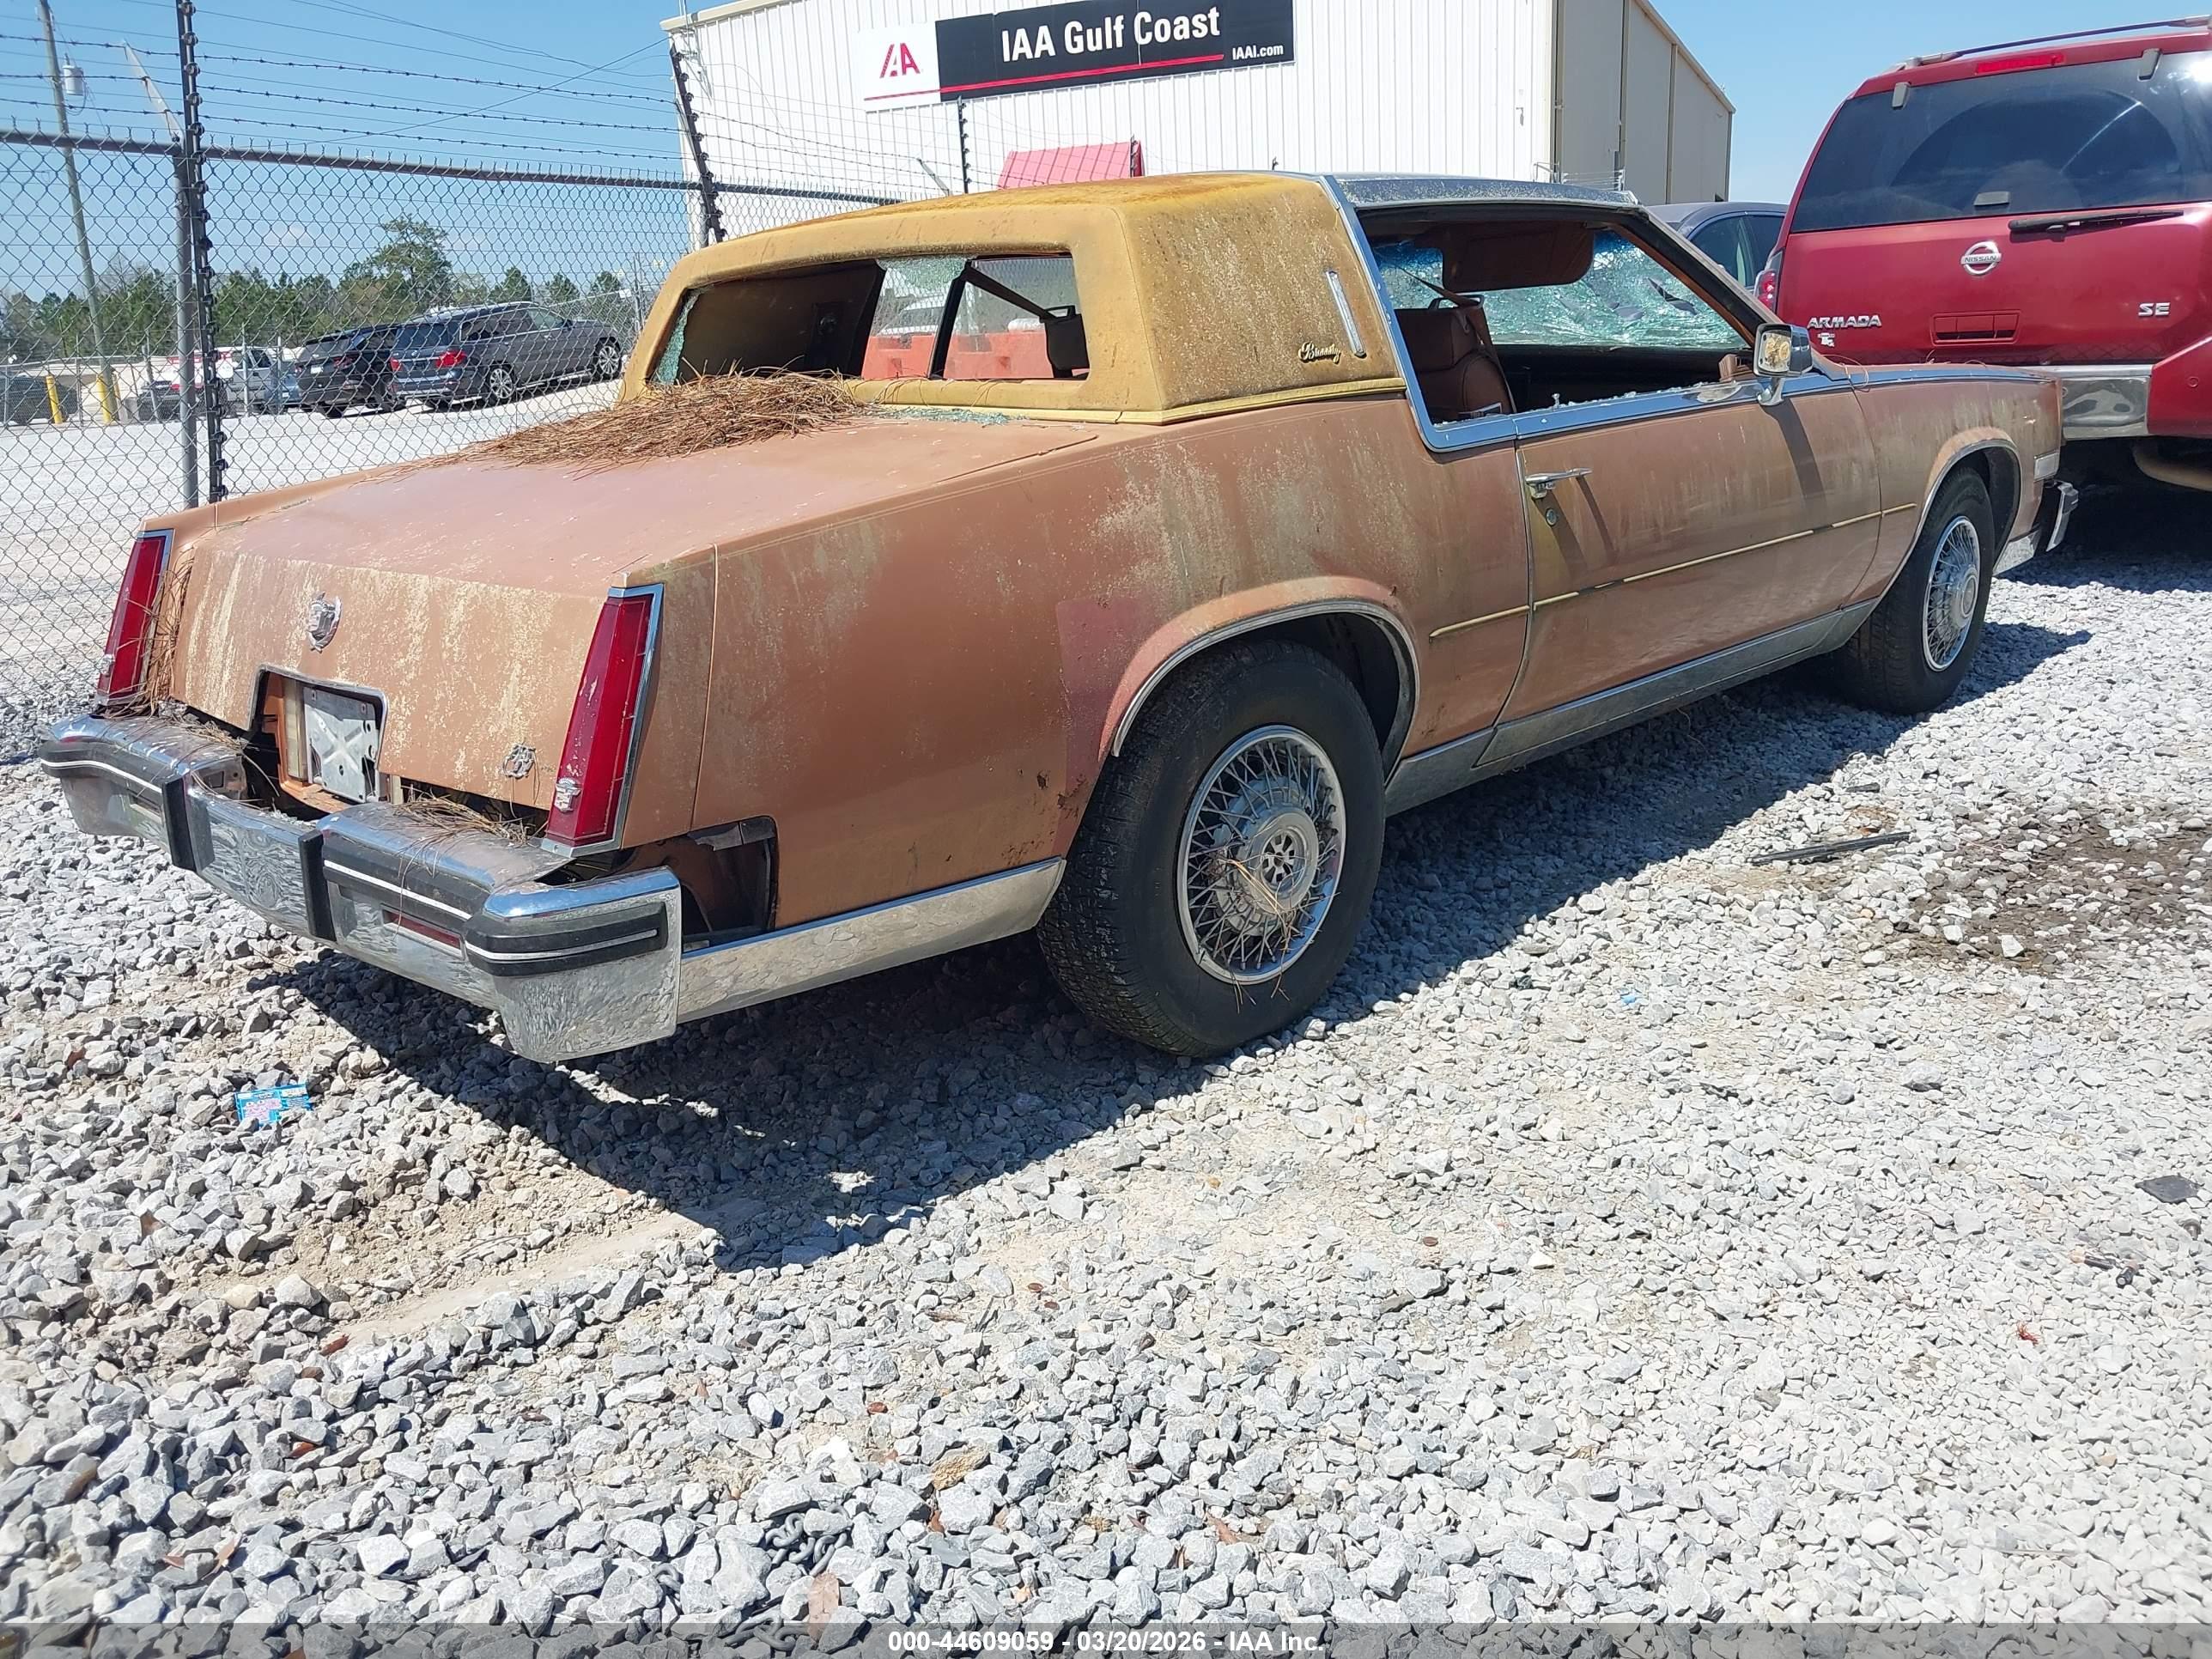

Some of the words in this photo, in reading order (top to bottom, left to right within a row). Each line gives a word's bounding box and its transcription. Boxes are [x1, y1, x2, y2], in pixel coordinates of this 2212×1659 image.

[1001, 25, 1056, 63] IAA
[1064, 15, 1125, 54] Gulf
[1133, 6, 1221, 46] Coast
[1232, 45, 1284, 60] IAAI.com
[2138, 302, 2171, 317] SE
[1807, 314, 1883, 329] ARMADA
